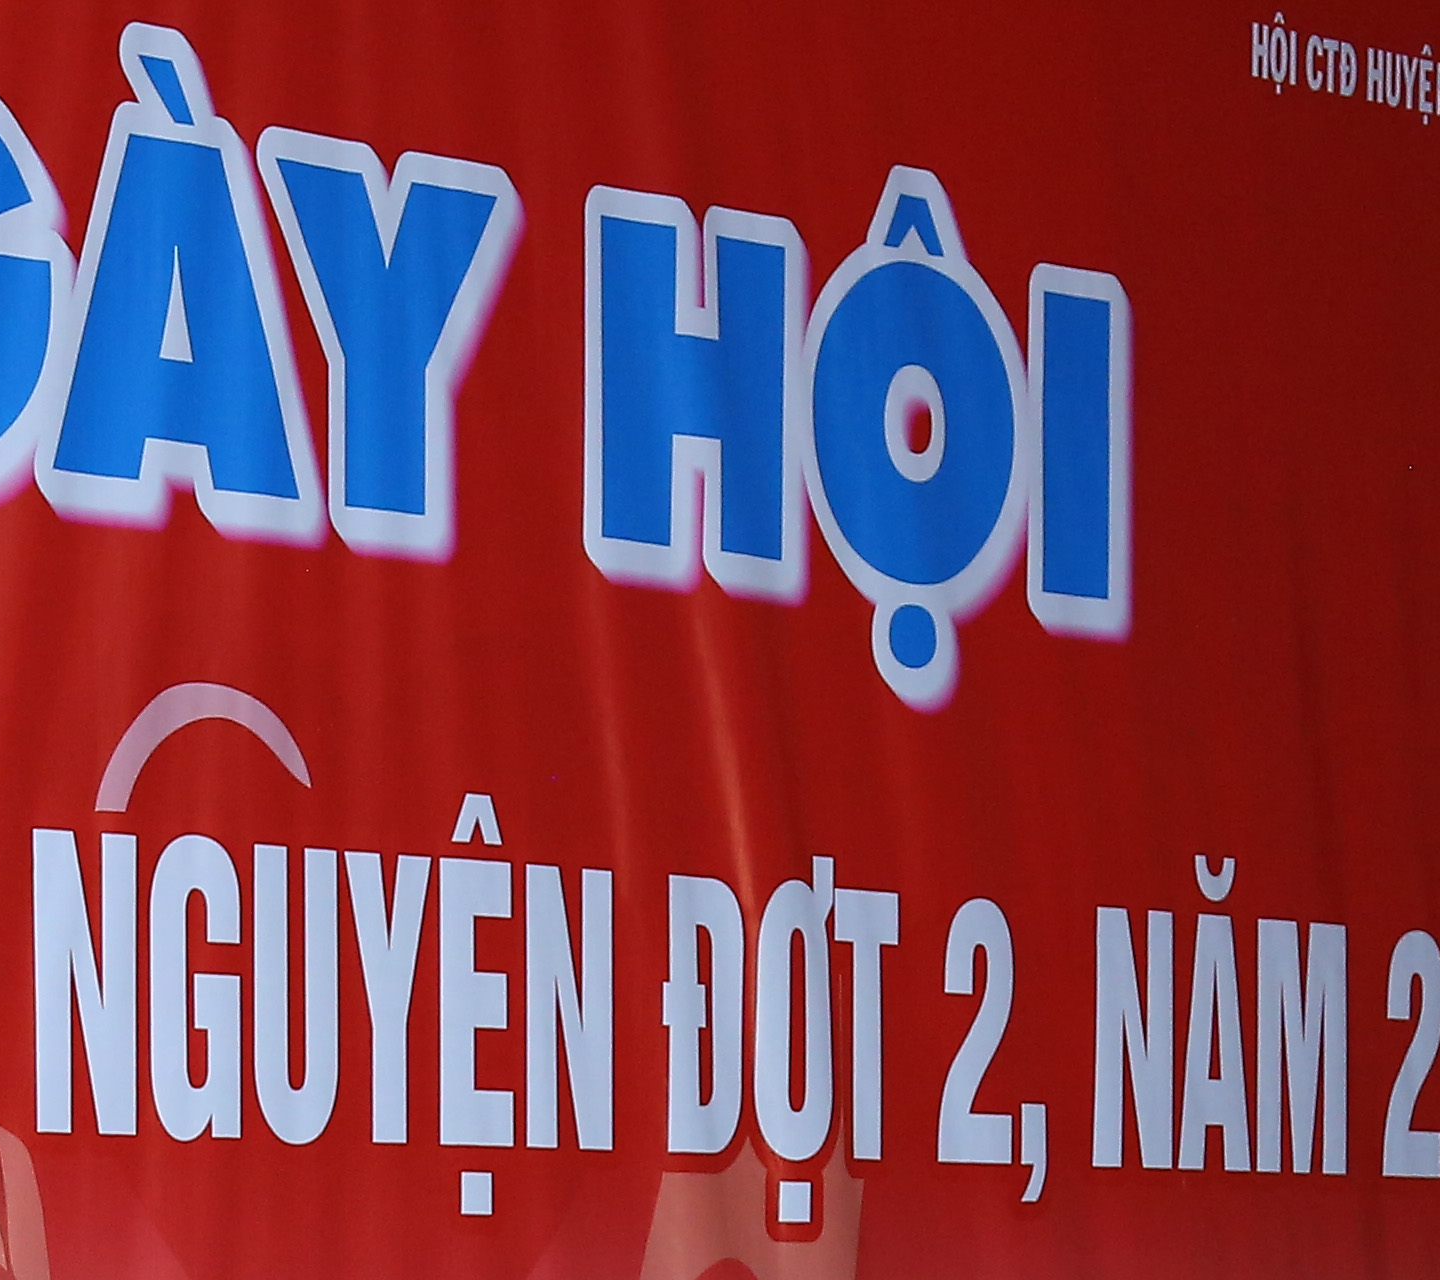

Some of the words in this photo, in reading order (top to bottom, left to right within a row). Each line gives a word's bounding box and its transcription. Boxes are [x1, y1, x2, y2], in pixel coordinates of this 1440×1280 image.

[1251, 11, 1298, 95] HỘI
[1305, 34, 1358, 97] CTĐ
[583, 165, 1131, 708] HỘI
[32, 793, 614, 1215] NGUYỆN
[662, 855, 900, 1223] ĐỢT
[937, 898, 1048, 1203] 2,
[1092, 855, 1348, 1174] NĂM
